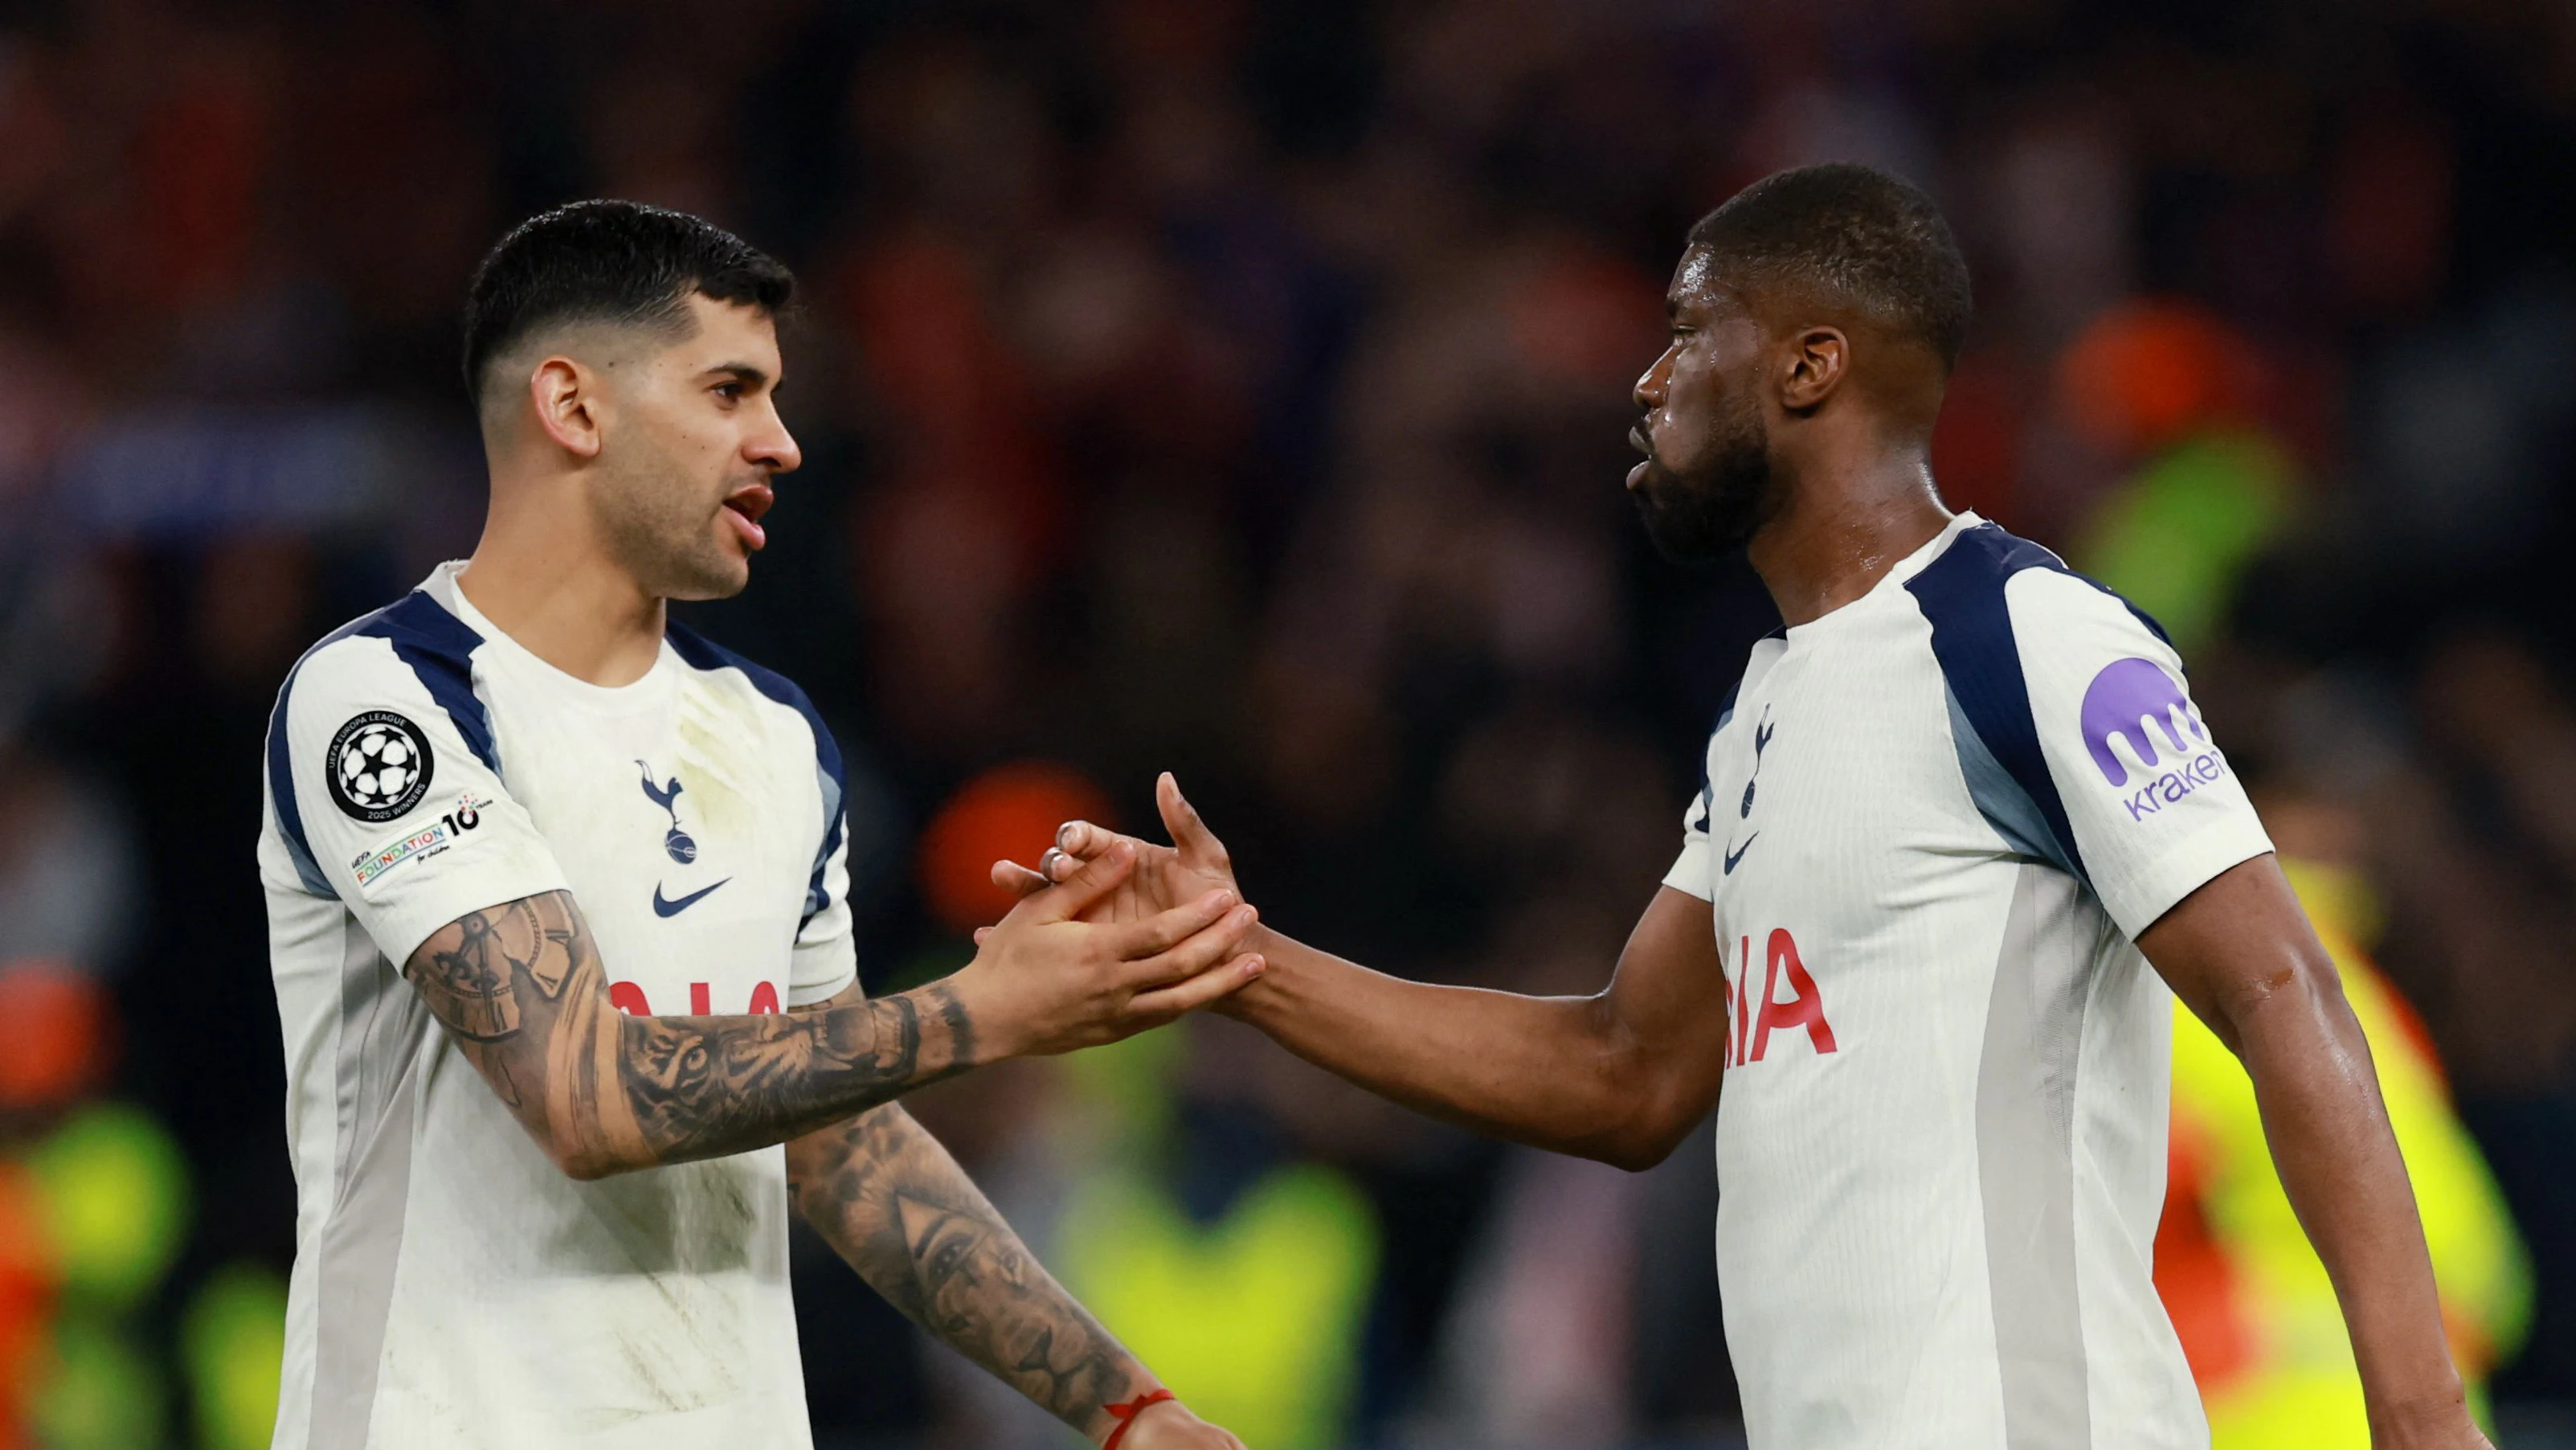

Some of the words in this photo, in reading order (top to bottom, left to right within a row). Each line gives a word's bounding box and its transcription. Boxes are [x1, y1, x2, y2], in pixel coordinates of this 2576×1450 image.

[329, 744, 339, 768] UEFA
[338, 716, 367, 743] EUROPA
[369, 713, 407, 727] LEAGUE
[367, 811, 391, 819] 2025
[393, 783, 426, 815] WINNERS
[443, 809, 479, 837] 10
[352, 850, 371, 868] UEFA
[357, 827, 444, 883] FOUNDATION
[1726, 928, 1838, 1069] IA
